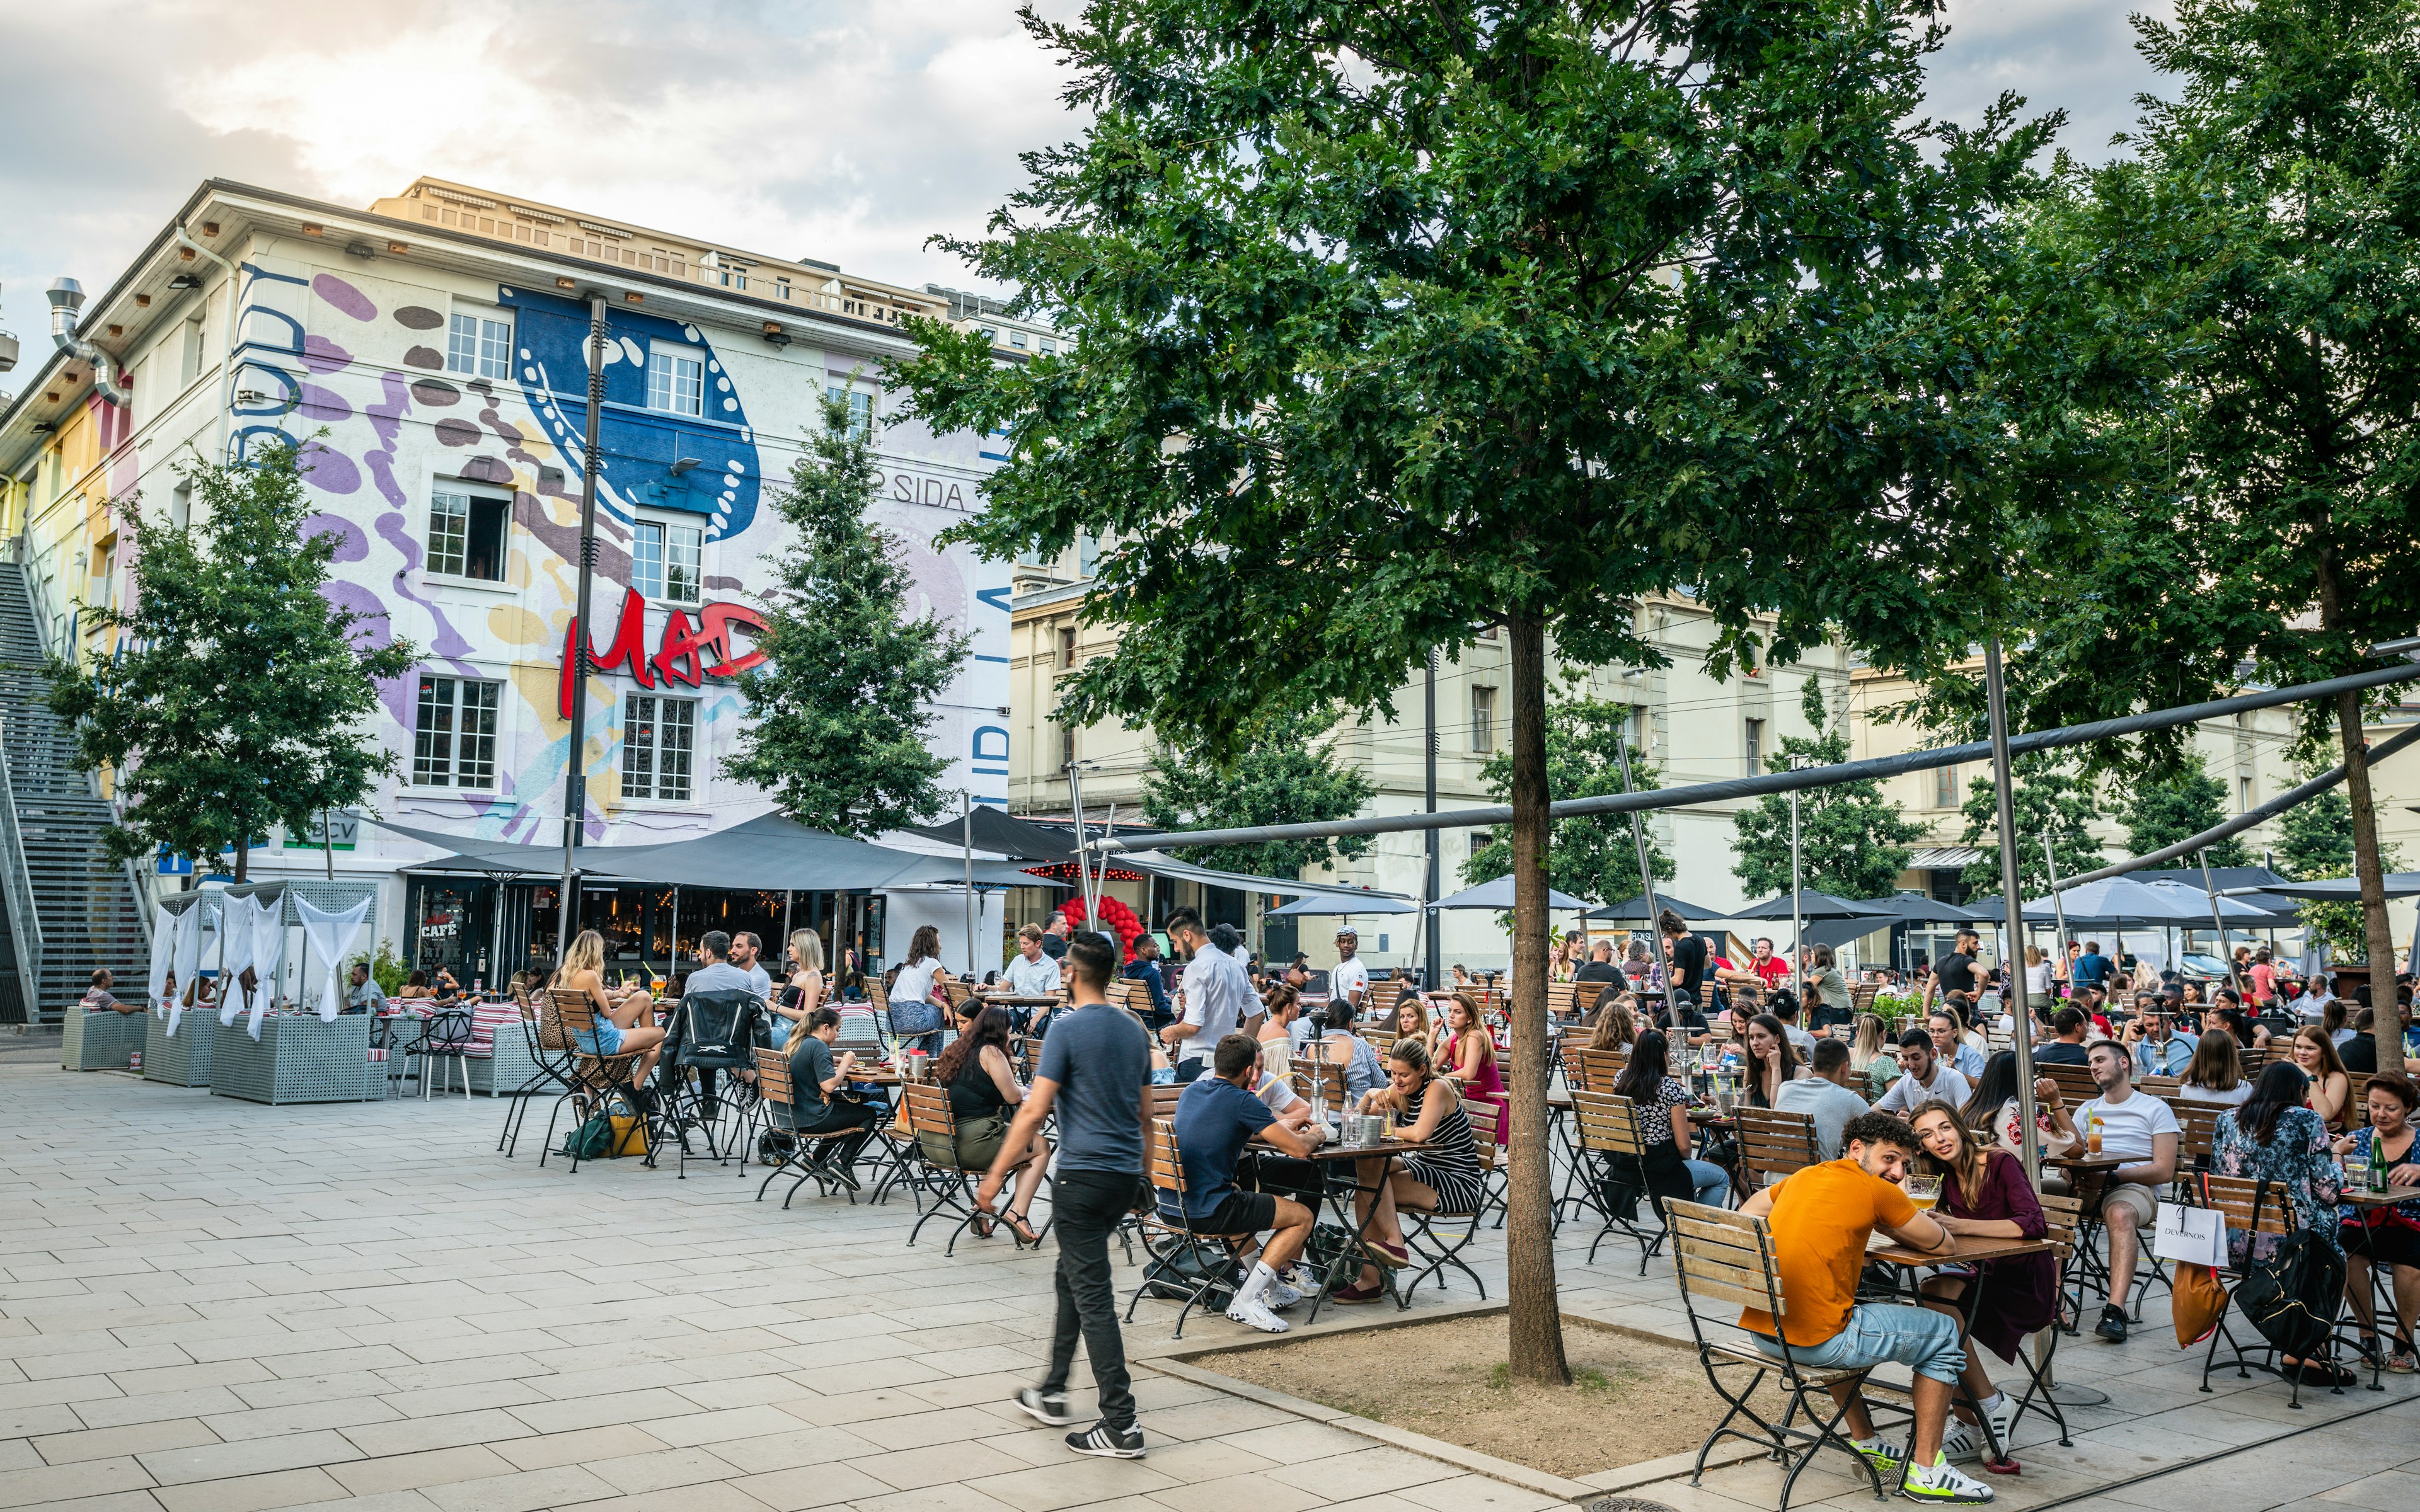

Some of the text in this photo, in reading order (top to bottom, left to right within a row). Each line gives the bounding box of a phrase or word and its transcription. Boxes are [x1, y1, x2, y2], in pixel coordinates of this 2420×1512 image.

[894, 474, 965, 511] SIDA
[558, 586, 775, 720] MAD
[313, 822, 355, 839] BCV
[422, 920, 457, 937] CAFÉ
[2165, 1227, 2205, 1240] DEVERNOIS
